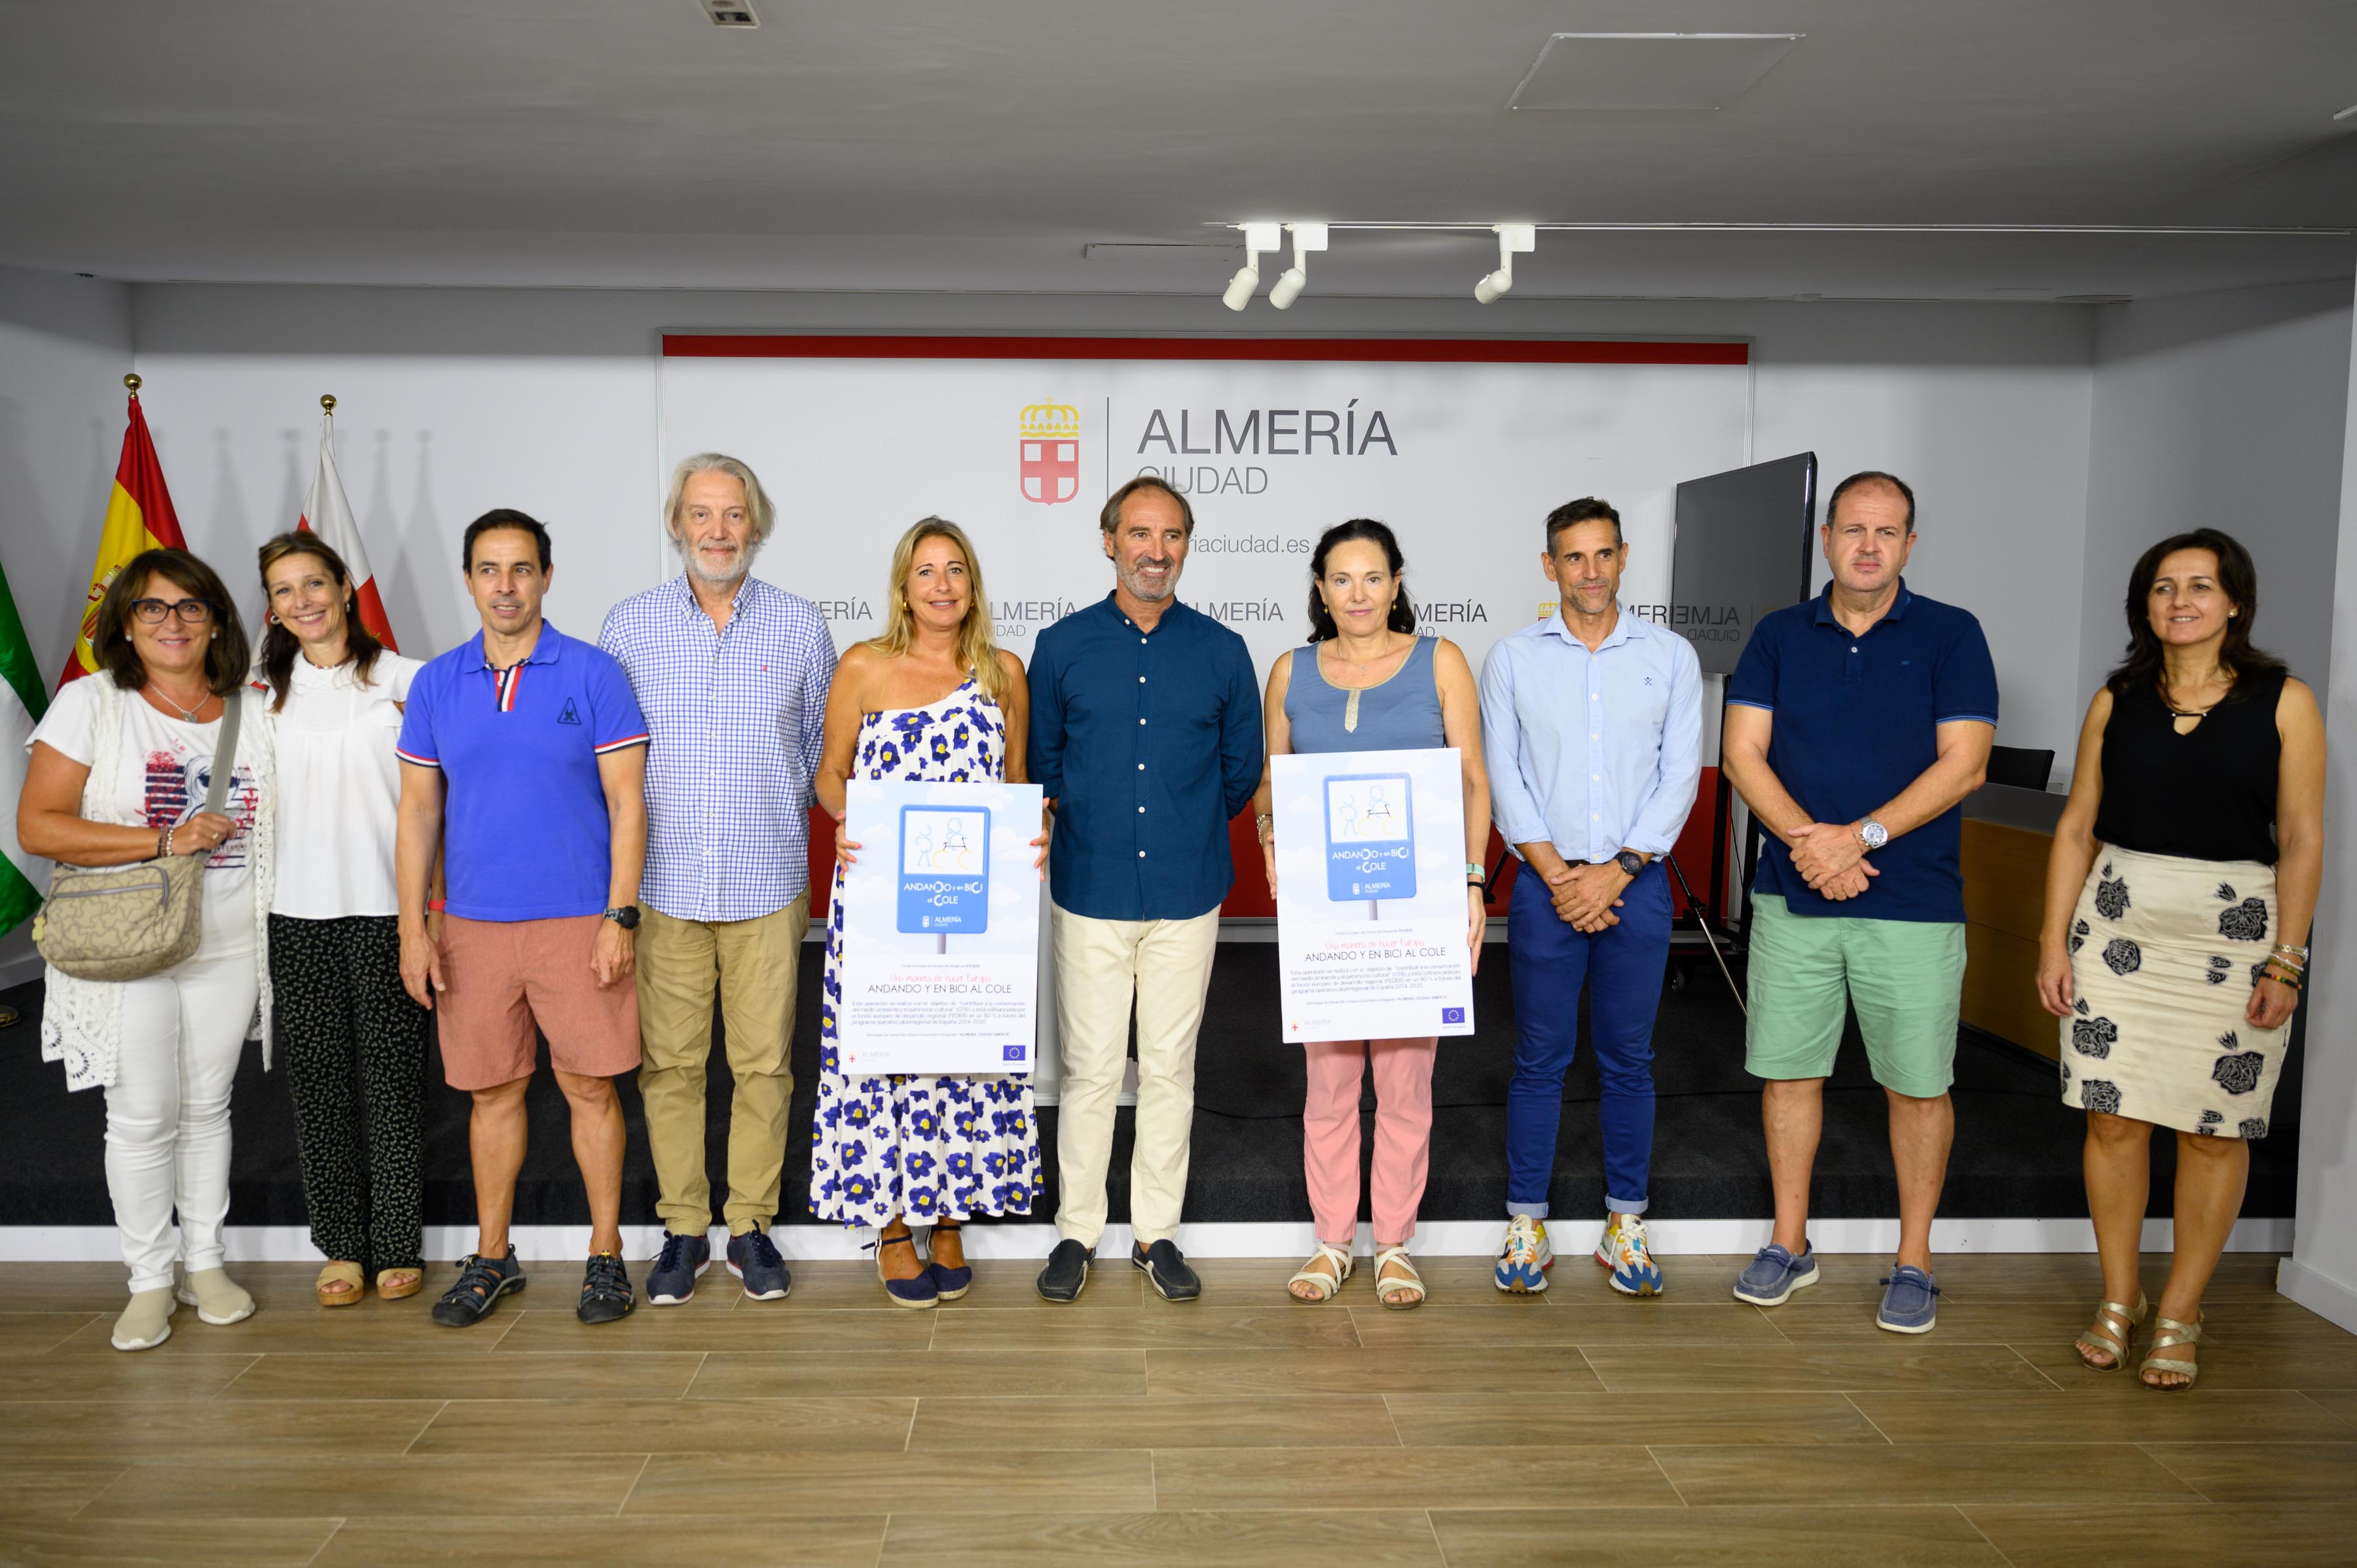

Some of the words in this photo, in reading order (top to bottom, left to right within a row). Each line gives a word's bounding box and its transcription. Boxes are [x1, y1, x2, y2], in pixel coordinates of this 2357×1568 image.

[1137, 398, 1398, 456] ALMERÍA
[812, 596, 873, 620] ERÍA
[990, 597, 1076, 621] LMERÍA
[1414, 599, 1488, 622] MERÍA
[996, 625, 1026, 636] DAD
[1362, 861, 1386, 873] COLE
[934, 894, 958, 907] COLE
[1305, 951, 1357, 962] ANDANDO
[1360, 951, 1366, 959] Y
[1369, 950, 1381, 959] EN
[1384, 949, 1402, 958] BICI
[1405, 949, 1417, 957] AL
[1419, 947, 1446, 957] COLE
[868, 984, 922, 994] ANDANDO
[924, 984, 930, 993] Y
[934, 984, 946, 993] EN
[949, 984, 968, 993] BICI
[970, 984, 982, 993] AL
[985, 984, 1012, 993] COLE
